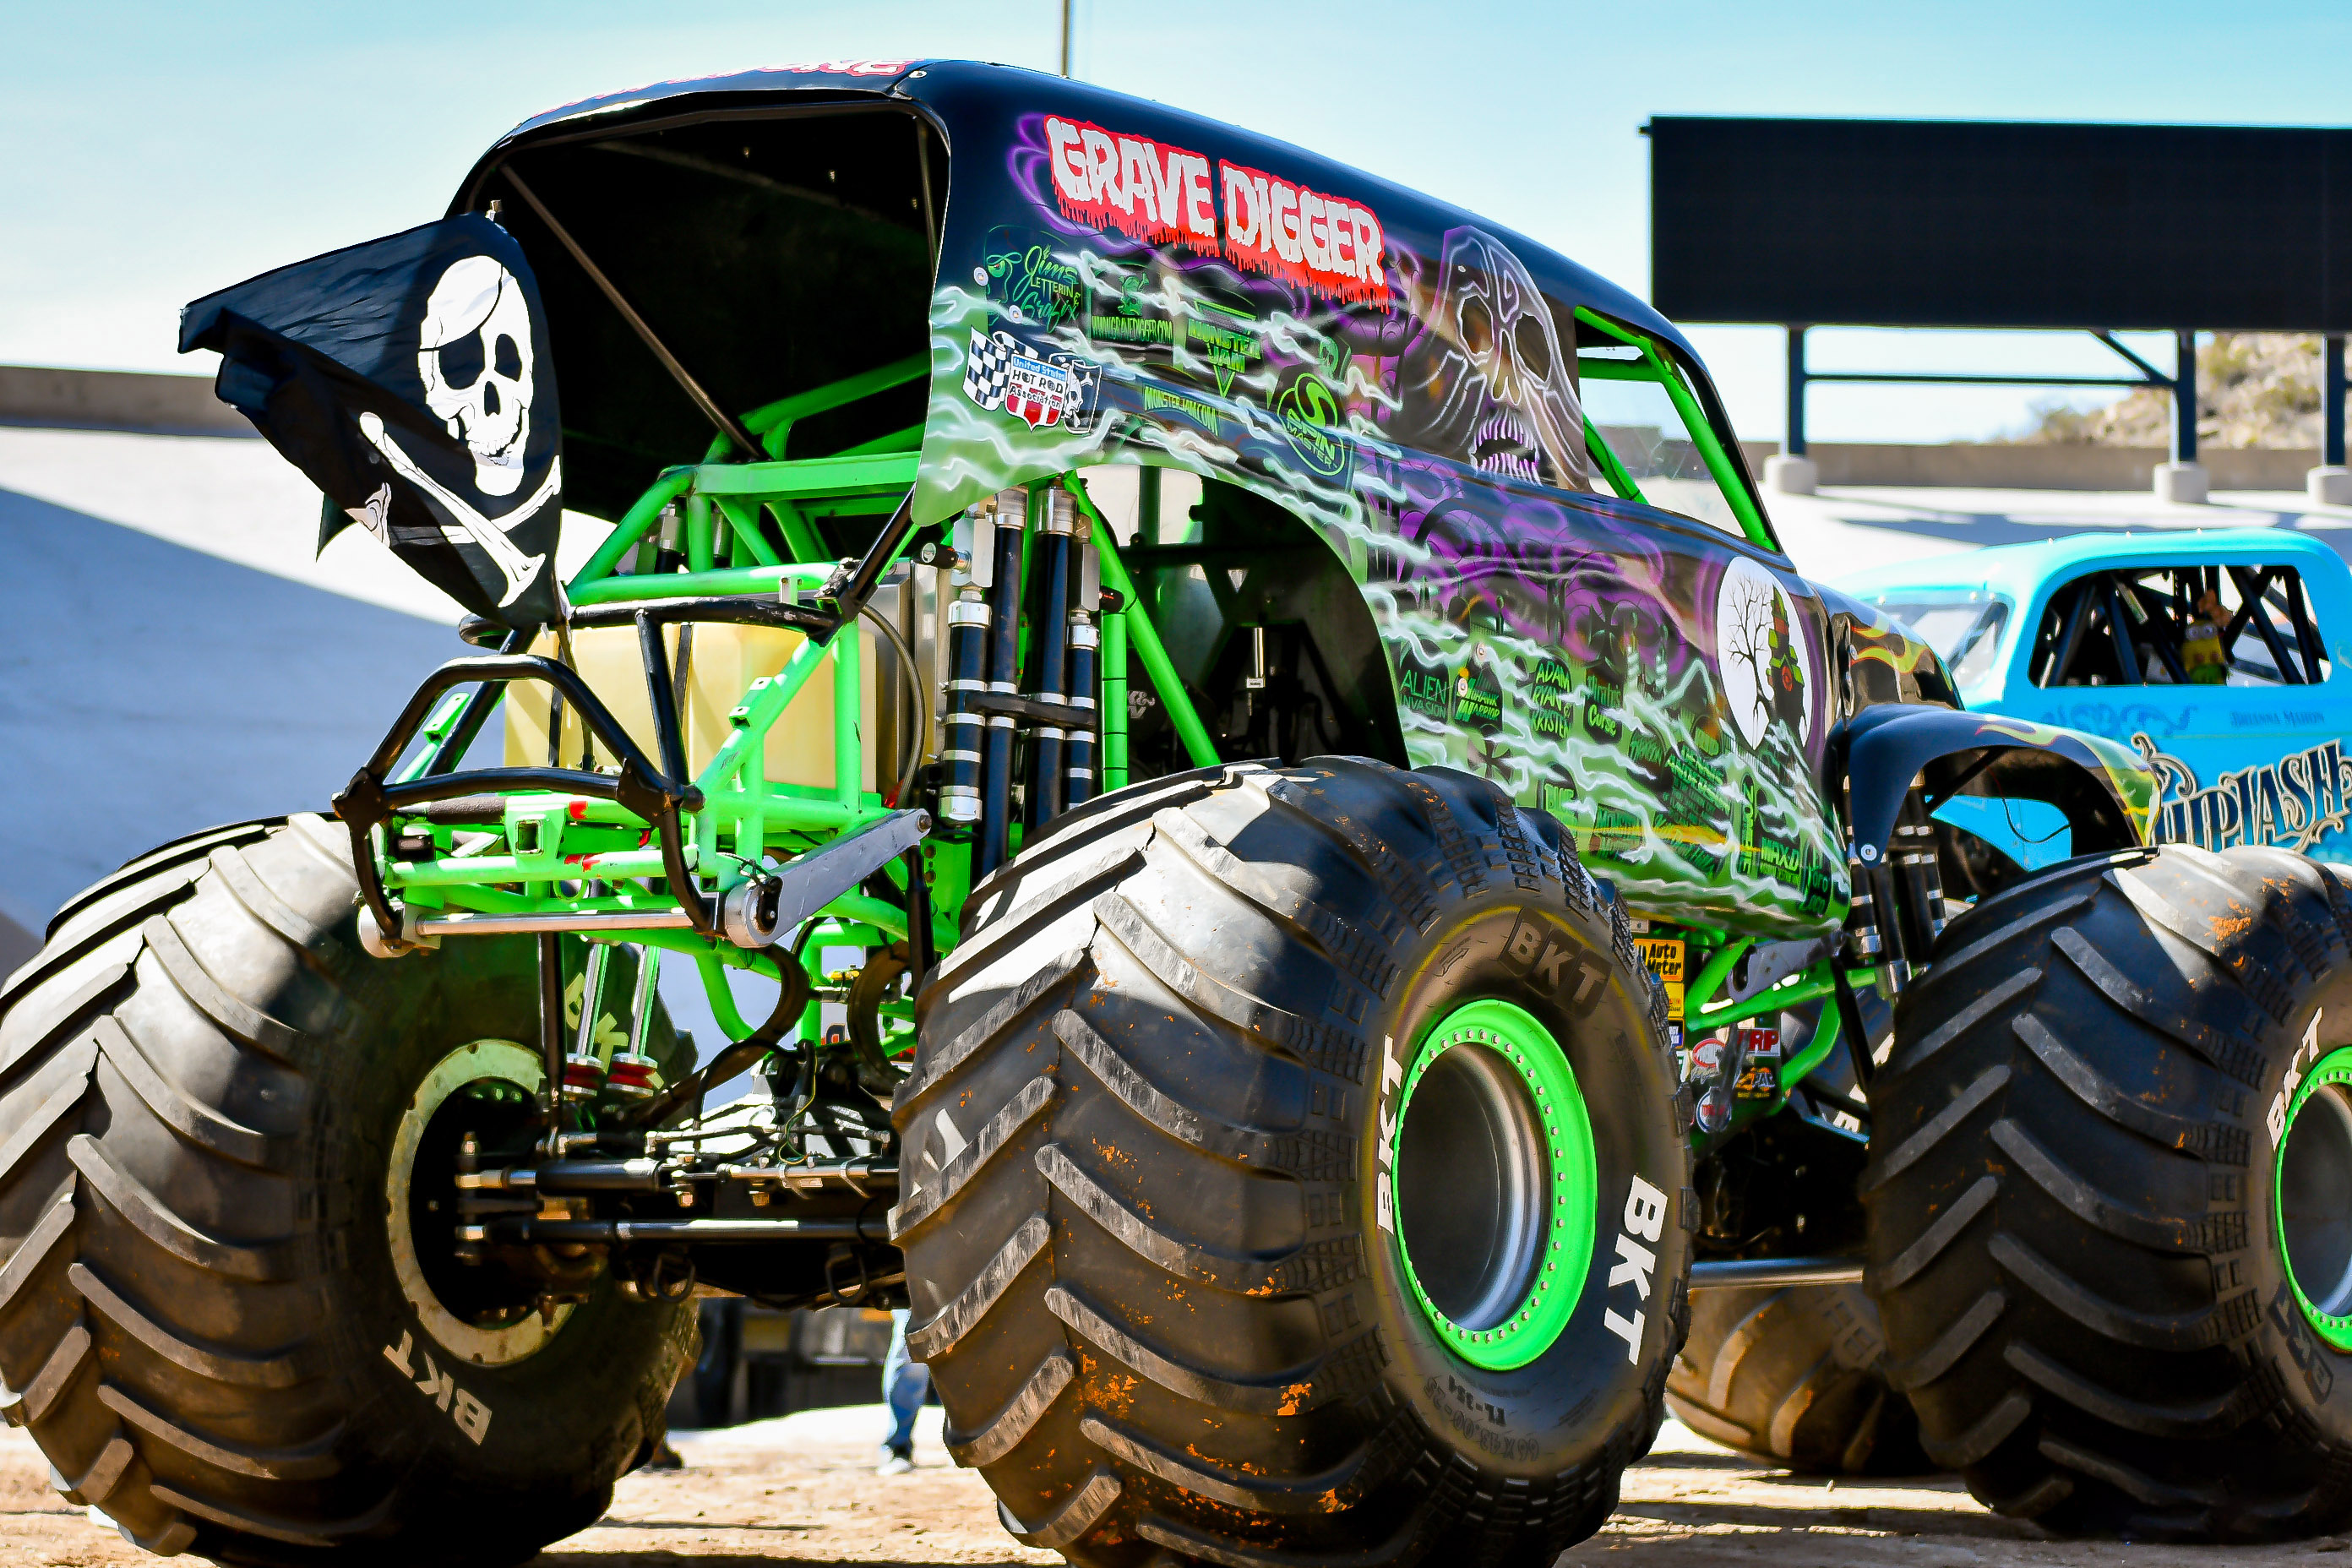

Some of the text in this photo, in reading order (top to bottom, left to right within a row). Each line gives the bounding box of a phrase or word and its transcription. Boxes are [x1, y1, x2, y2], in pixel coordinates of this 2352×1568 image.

[1045, 117, 1386, 287] GRAVE DIGGER
[1187, 318, 1261, 360] MONSTER
[1014, 357, 1066, 382] United States
[1207, 346, 1245, 374] JAM
[1009, 385, 1061, 409] Association
[1013, 369, 1064, 395] HOT ROD
[1287, 408, 1335, 461] SPIN
[1290, 424, 1332, 470] MASTER
[1399, 669, 1447, 705] ALIEN
[1535, 660, 1571, 693] ADAM
[1399, 694, 1447, 720] INVASION
[1453, 699, 1501, 722] WARRIOR
[1533, 684, 1563, 711] RYAN
[1531, 708, 1571, 739] KRISTEN
[1587, 704, 1617, 738] Curse
[1508, 920, 1607, 1004] BKT
[1648, 943, 1677, 960] Auto
[2266, 1006, 2323, 1152] BKT
[1376, 1033, 1403, 1236] BKT
[1603, 1173, 1669, 1367] BKT
[384, 1328, 493, 1446] BKT
